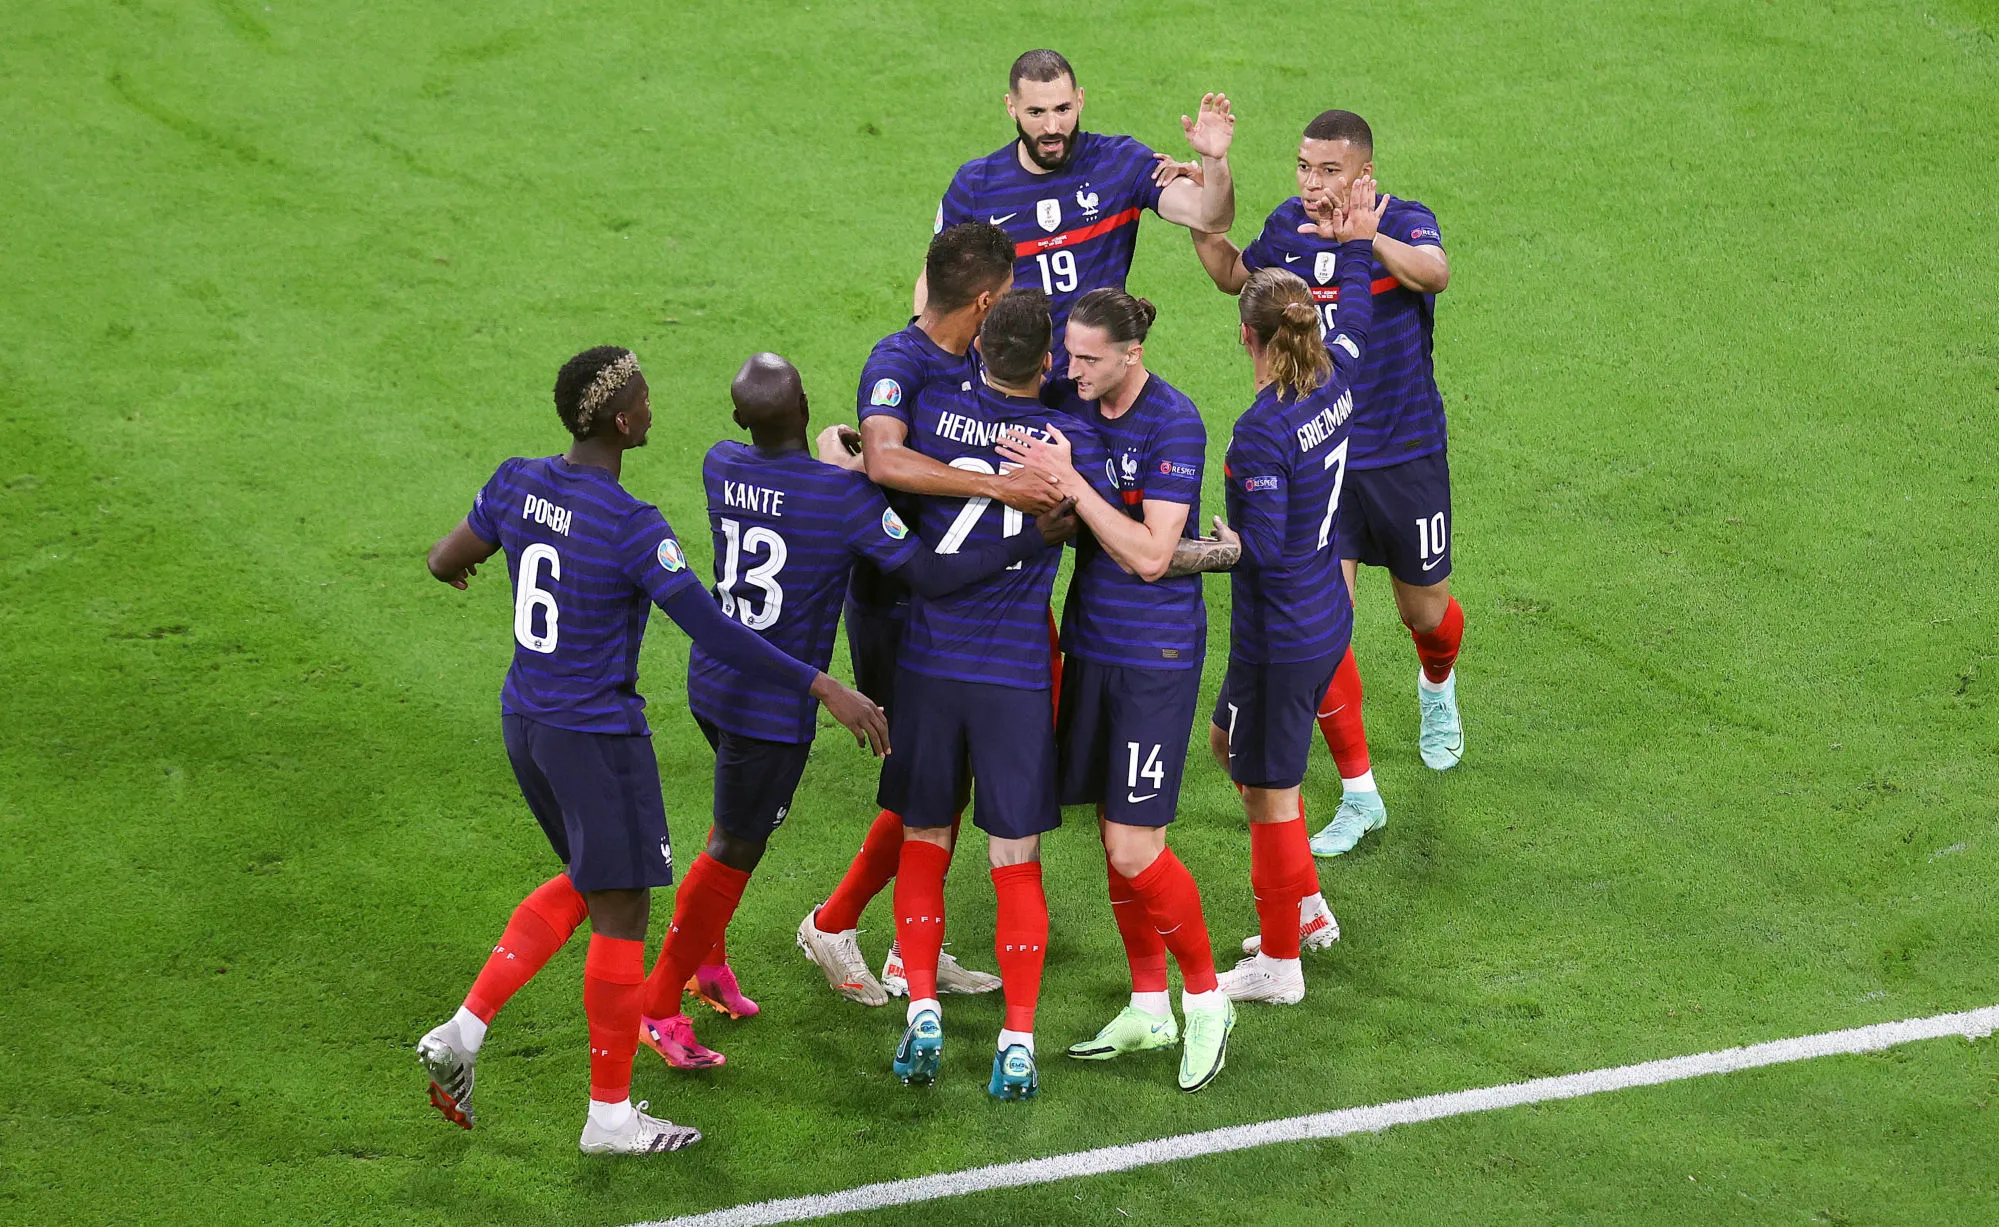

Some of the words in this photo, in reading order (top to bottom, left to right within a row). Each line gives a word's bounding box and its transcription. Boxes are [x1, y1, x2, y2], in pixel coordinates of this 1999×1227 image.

[1036, 250, 1078, 296] 19
[1172, 465, 1196, 476] RESPECT
[1317, 436, 1349, 551] 7
[522, 494, 572, 537] POGBA
[724, 480, 785, 517] KANTE
[1415, 511, 1446, 559] 10
[514, 542, 561, 654] 6
[716, 517, 788, 631] 13
[1127, 741, 1165, 789] 14
